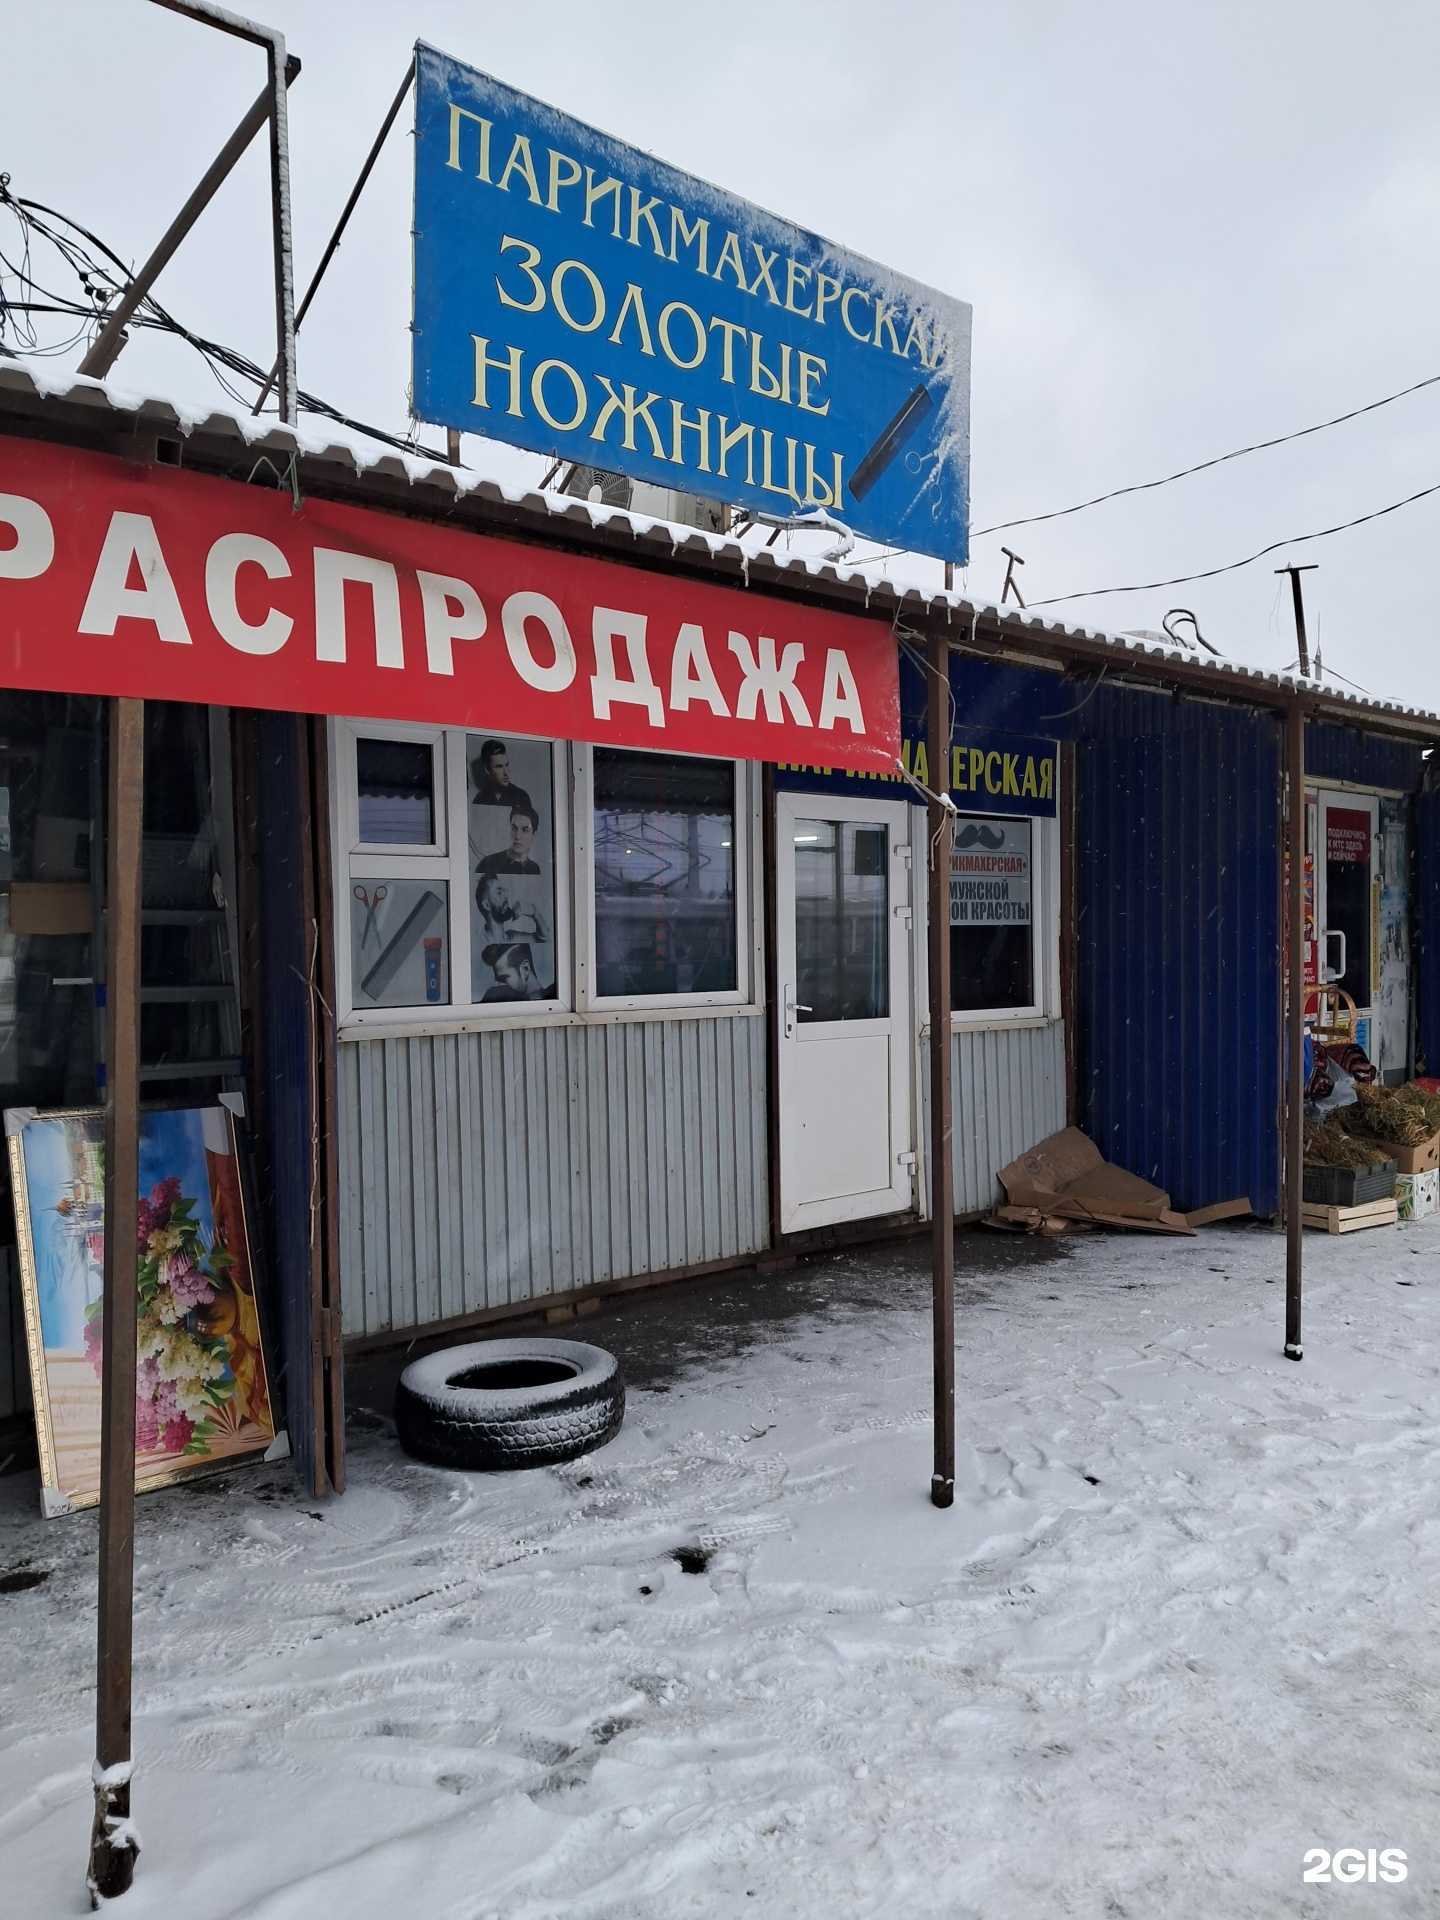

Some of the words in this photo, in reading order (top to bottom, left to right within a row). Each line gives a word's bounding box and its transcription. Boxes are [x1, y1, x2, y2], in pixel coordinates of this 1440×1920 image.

[495, 234, 830, 416] ЗОЛОТЫЕ
[469, 334, 845, 511] НОЖНИЦЫ
[971, 901, 1030, 921] КРАСОТЫ
